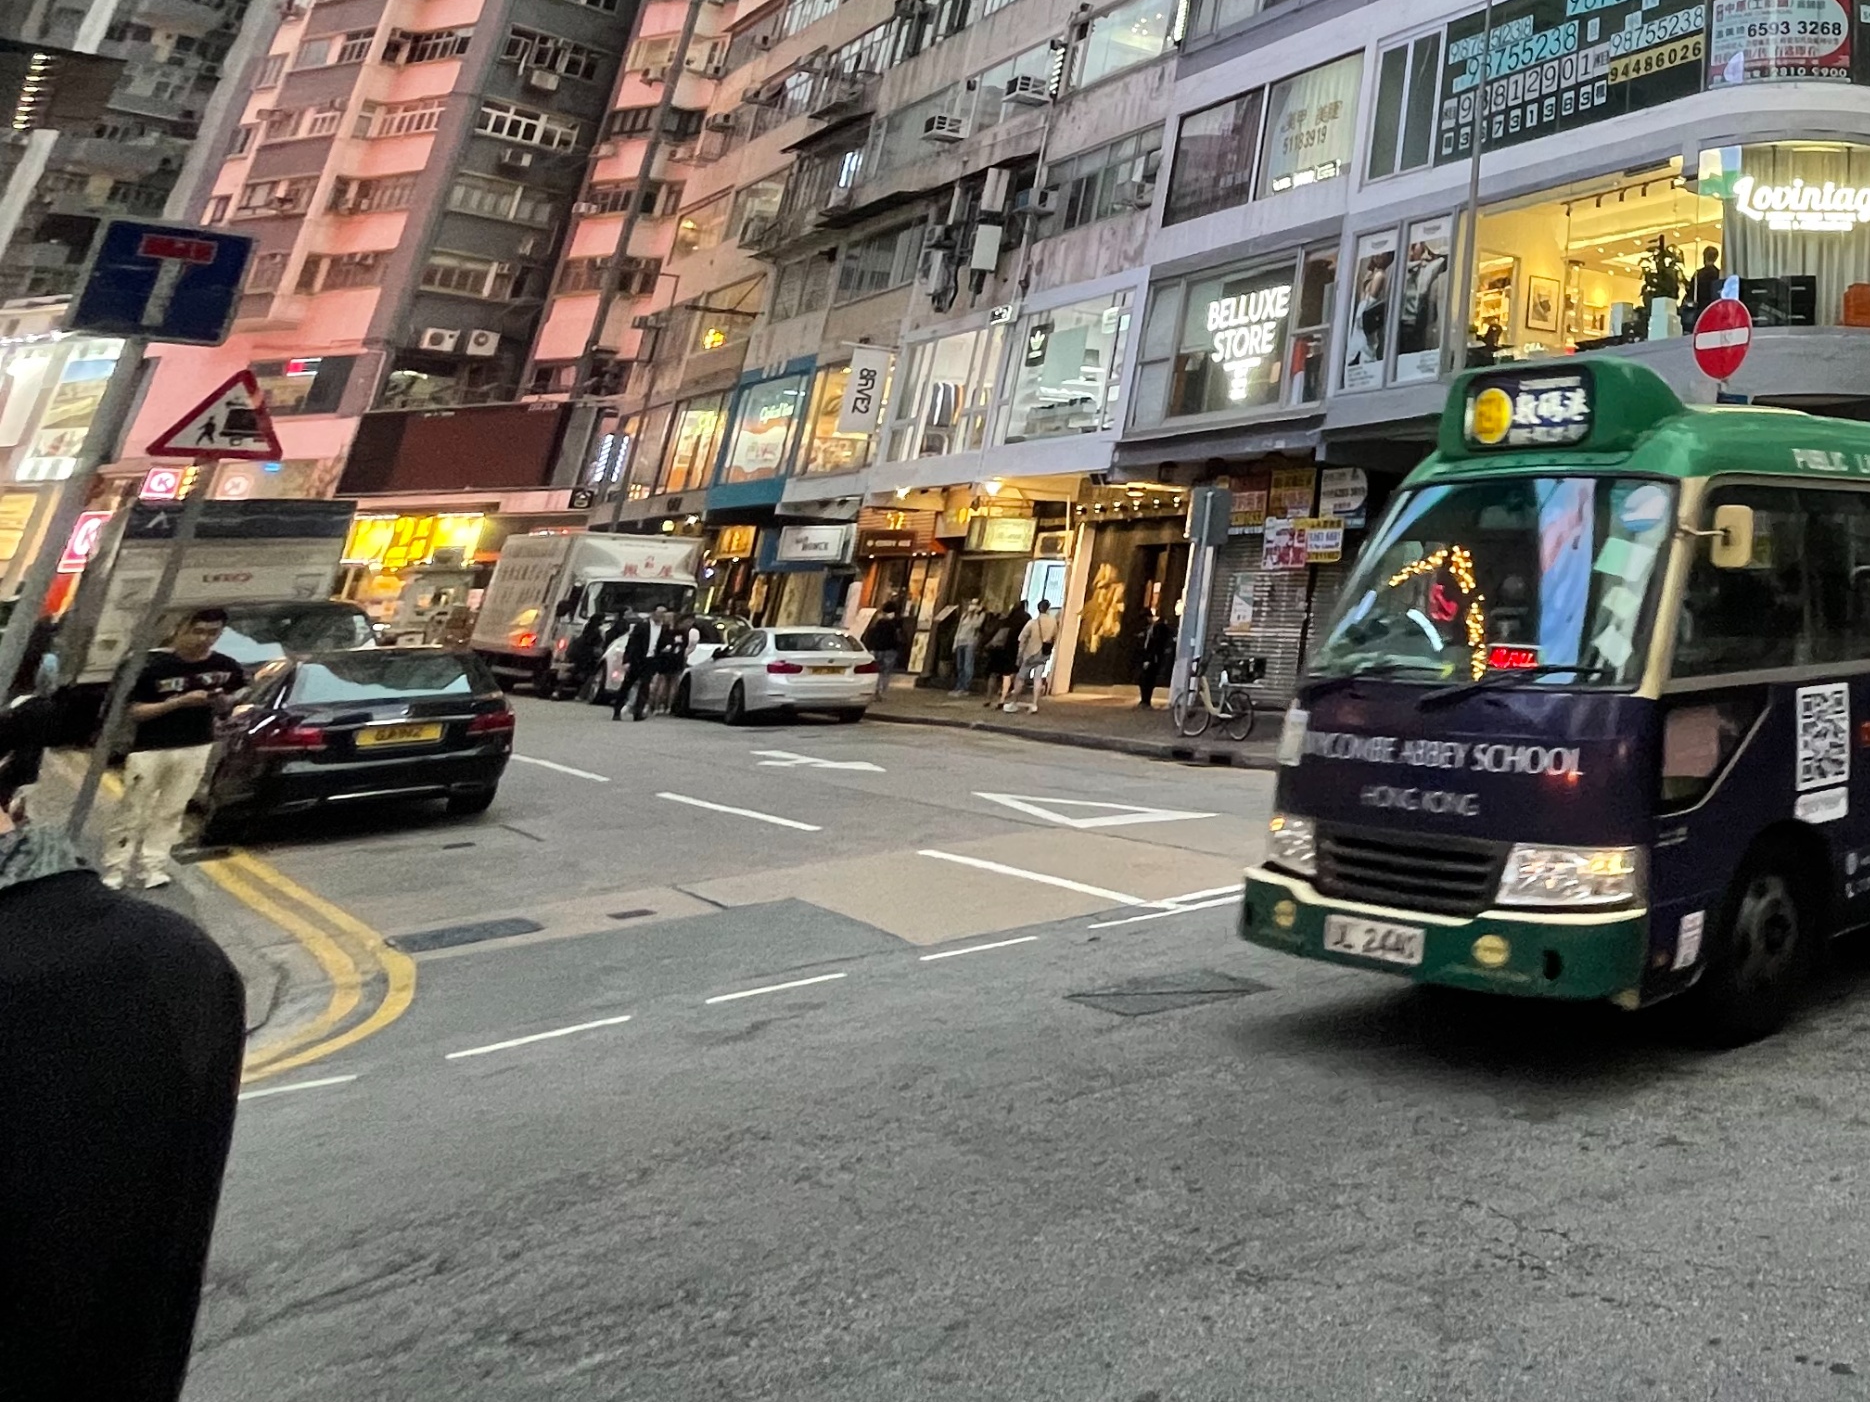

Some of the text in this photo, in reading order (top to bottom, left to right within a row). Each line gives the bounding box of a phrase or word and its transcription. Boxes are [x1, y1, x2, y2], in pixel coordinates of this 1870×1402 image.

[1611, 4, 1705, 57] 98755238
[1747, 20, 1791, 38] 6593
[1797, 20, 1843, 37] 3268
[1609, 40, 1703, 83] 94486026
[1206, 284, 1292, 332] BELLUXE
[1211, 321, 1278, 363] STORE
[1399, 737, 1468, 769] ABBEY
[1471, 742, 1585, 776] SCHOOL
